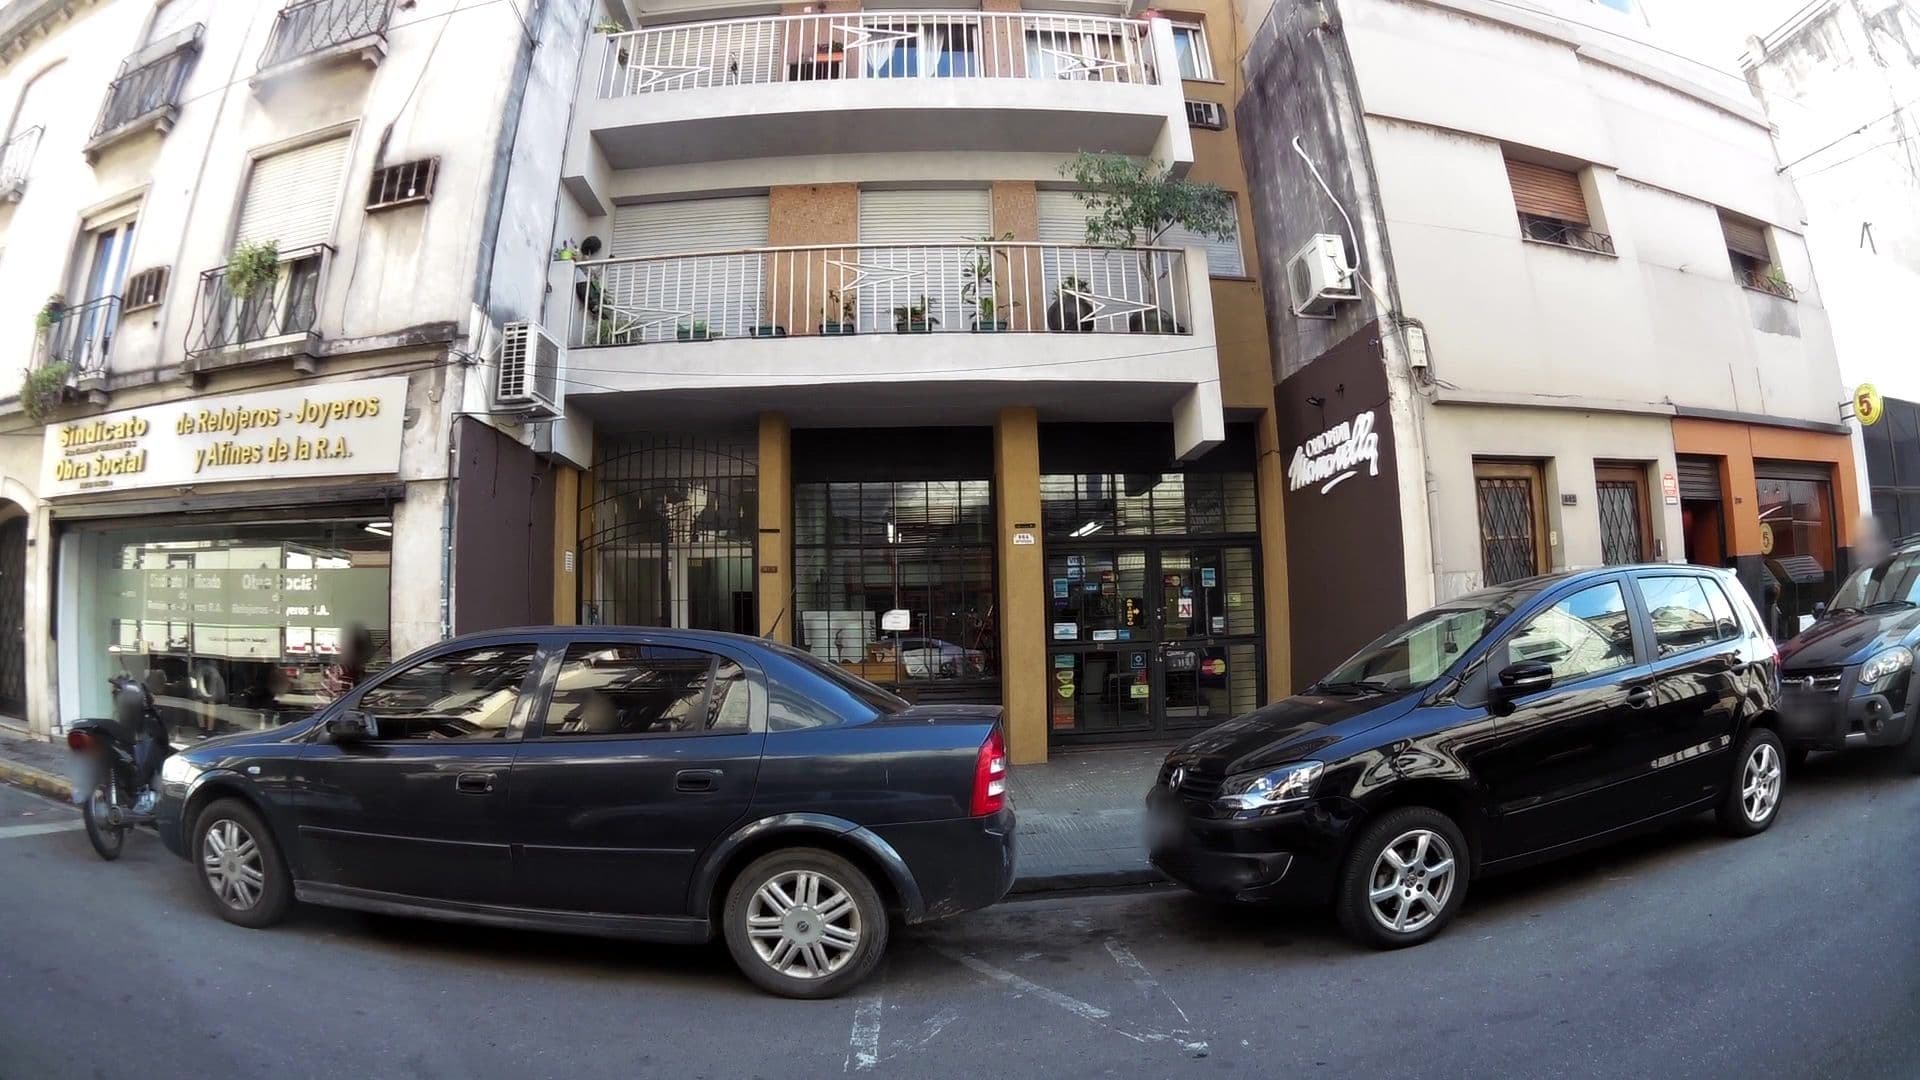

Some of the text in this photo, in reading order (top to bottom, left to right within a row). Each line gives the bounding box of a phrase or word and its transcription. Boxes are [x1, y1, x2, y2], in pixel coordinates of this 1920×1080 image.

[176, 412, 194, 434] de
[199, 406, 280, 435] Relojeros
[296, 396, 379, 428] Joyeros
[1858, 393, 1872, 416] 5
[60, 416, 149, 448] Sindicato
[56, 449, 147, 481] Obra Social
[194, 436, 353, 473] y Afines de la R.A.
